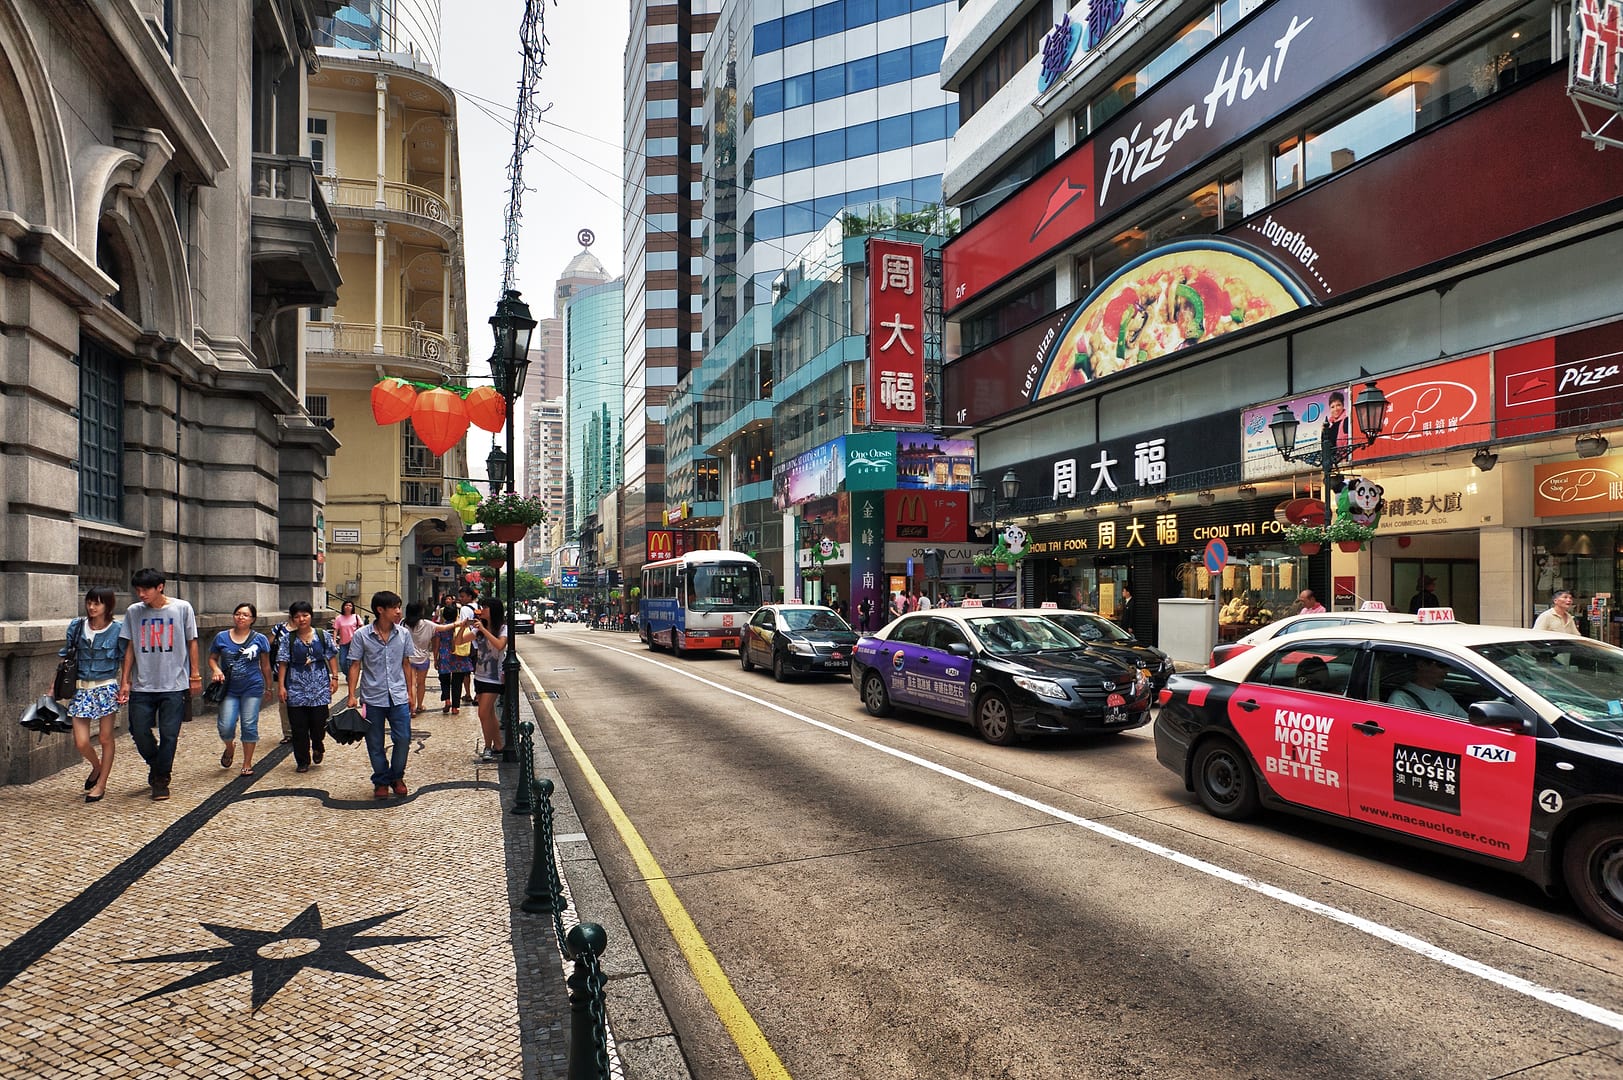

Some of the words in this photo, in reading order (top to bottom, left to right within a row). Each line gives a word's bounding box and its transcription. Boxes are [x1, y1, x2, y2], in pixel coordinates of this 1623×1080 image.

[1099, 104, 1198, 207] Pizza
[1203, 16, 1314, 128] Hut
[955, 283, 967, 299] 2/F
[880, 253, 916, 412] 周大福
[1020, 363, 1039, 398] Let's
[1035, 326, 1056, 363] pizza
[1558, 364, 1620, 392] Pizza
[956, 408, 967, 425] 1/F
[1307, 402, 1321, 423] D
[850, 449, 868, 459] One
[869, 448, 892, 458] Oasis
[1053, 438, 1167, 500] 周大福
[1097, 514, 1179, 549] 周大福
[1193, 526, 1230, 540] CHOW
[1233, 522, 1255, 536] TAI
[1380, 521, 1393, 529] WAH
[1393, 519, 1429, 528] COMMERCIAL
[1028, 542, 1047, 553] HOW
[1049, 541, 1061, 551] TAI
[1064, 538, 1088, 550] FOOK
[1429, 610, 1453, 621] TAXI
[1274, 708, 1334, 734] KNOW
[1274, 726, 1329, 751] MORE
[1395, 748, 1456, 771] MACAU
[1472, 745, 1510, 762] TAXI
[1265, 756, 1340, 788] BETTER
[1395, 760, 1456, 783] CLOSER
[1395, 773, 1456, 795] 澳門特寫
[1541, 793, 1558, 810] 4
[1359, 804, 1511, 850] www.macaucloser.com
